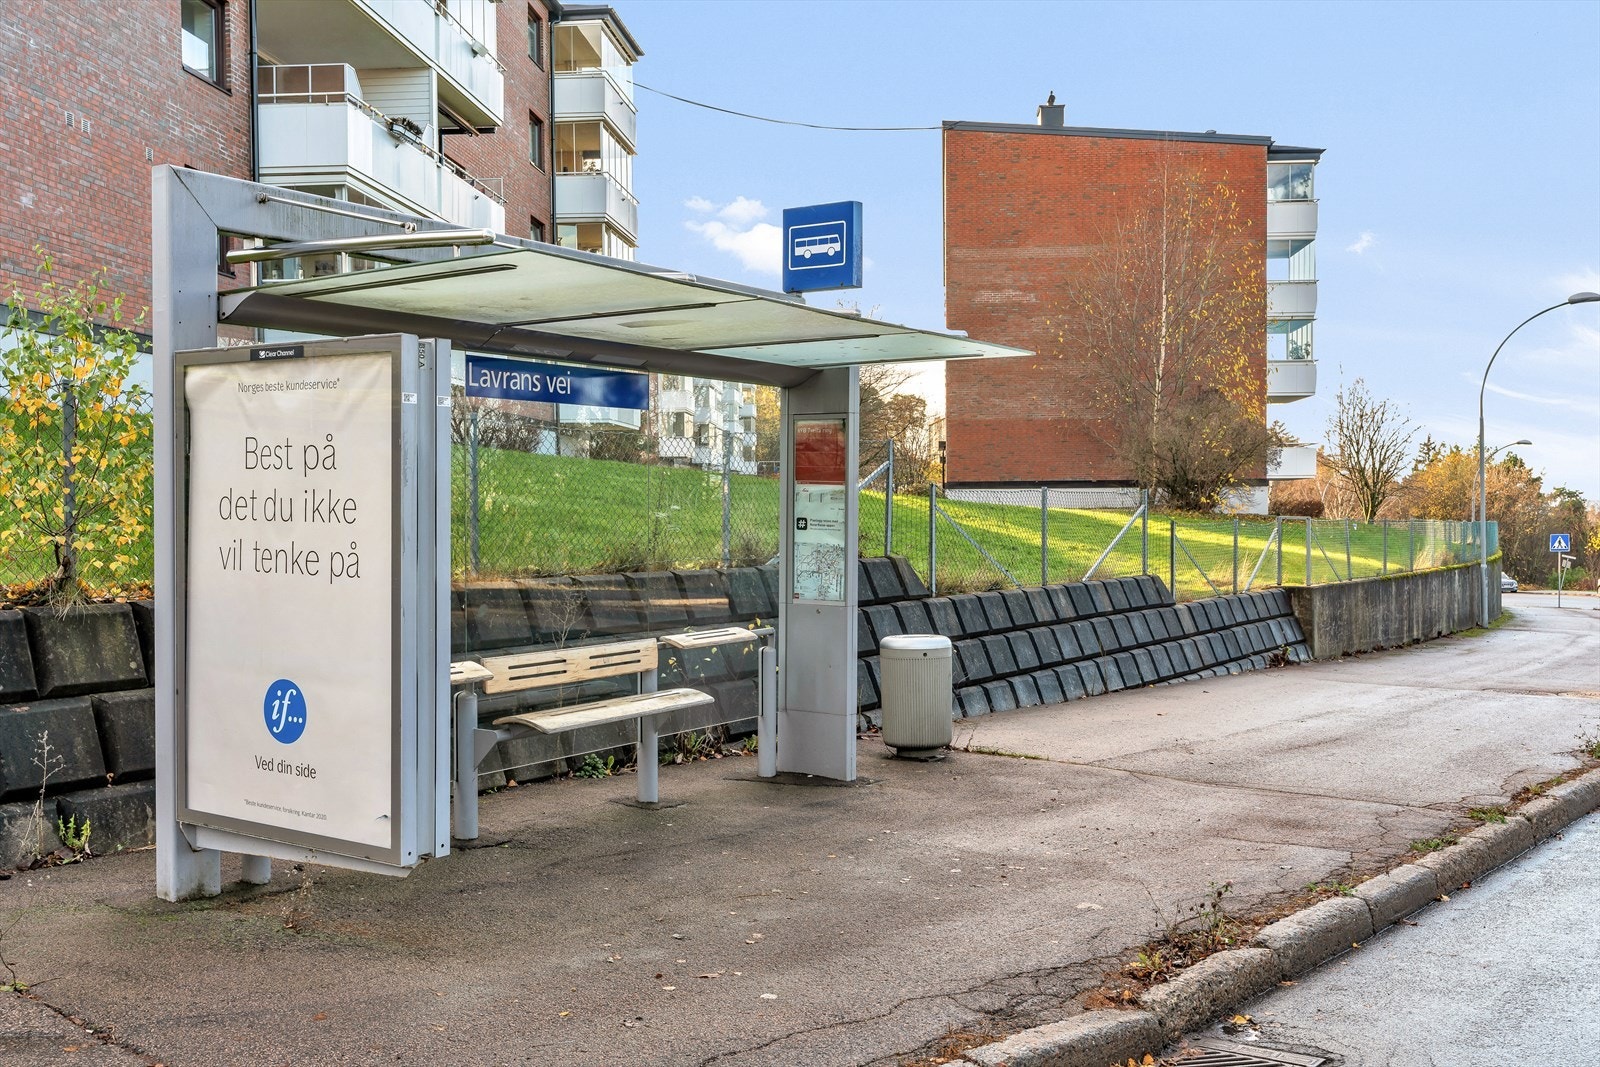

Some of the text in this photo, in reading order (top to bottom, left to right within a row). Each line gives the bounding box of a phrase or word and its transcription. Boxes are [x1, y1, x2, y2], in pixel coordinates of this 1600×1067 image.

[265, 349, 295, 358] Clear Channel
[237, 382, 264, 395] Norges
[264, 381, 284, 392] beste
[468, 362, 571, 395] Lavrans vei
[244, 433, 338, 478] Best på
[218, 487, 358, 525] det du ikke
[218, 538, 361, 585] vil tenke på
[254, 754, 318, 780] Ved din side
